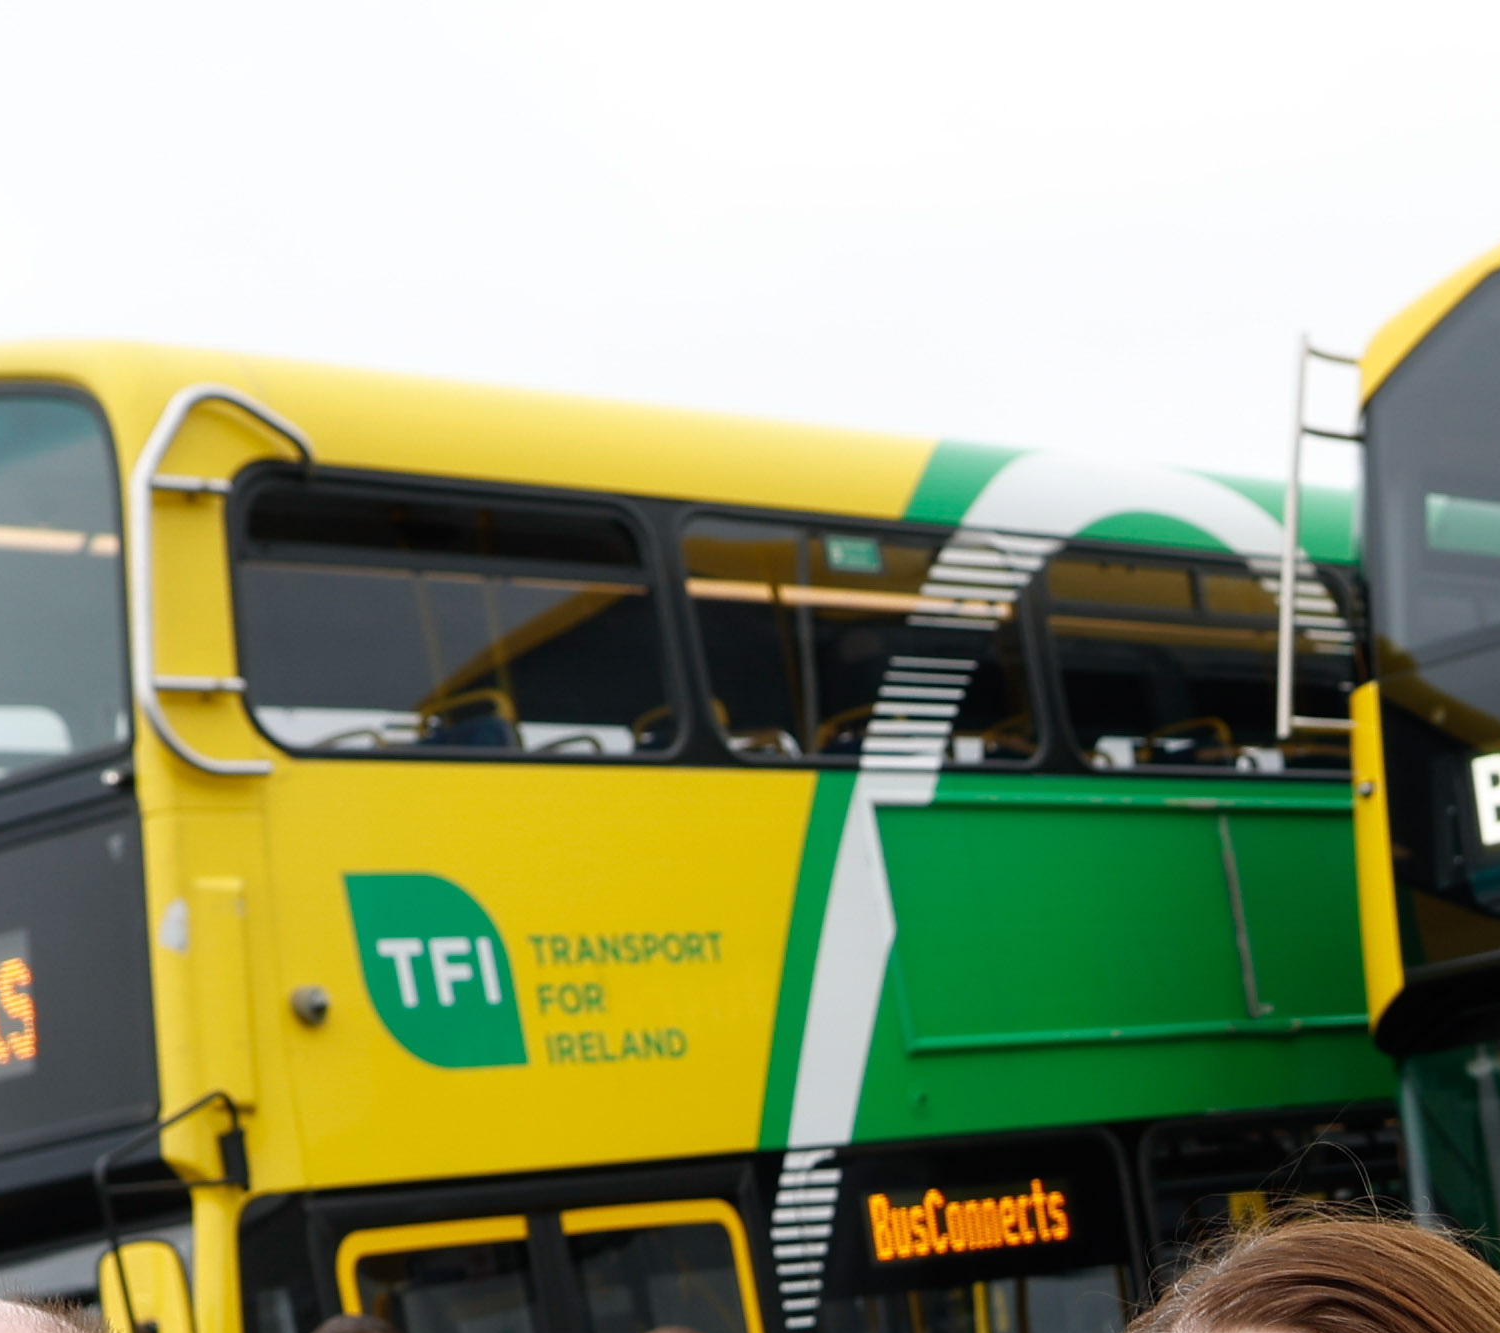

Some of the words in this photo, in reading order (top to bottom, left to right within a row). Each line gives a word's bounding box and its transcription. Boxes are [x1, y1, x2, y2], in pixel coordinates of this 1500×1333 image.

[527, 931, 724, 967] TRANSPORT
[375, 936, 502, 1009] TFI
[536, 983, 607, 1015] FOR
[545, 1028, 689, 1065] IRELAND
[868, 1177, 1070, 1262] BusConnects
